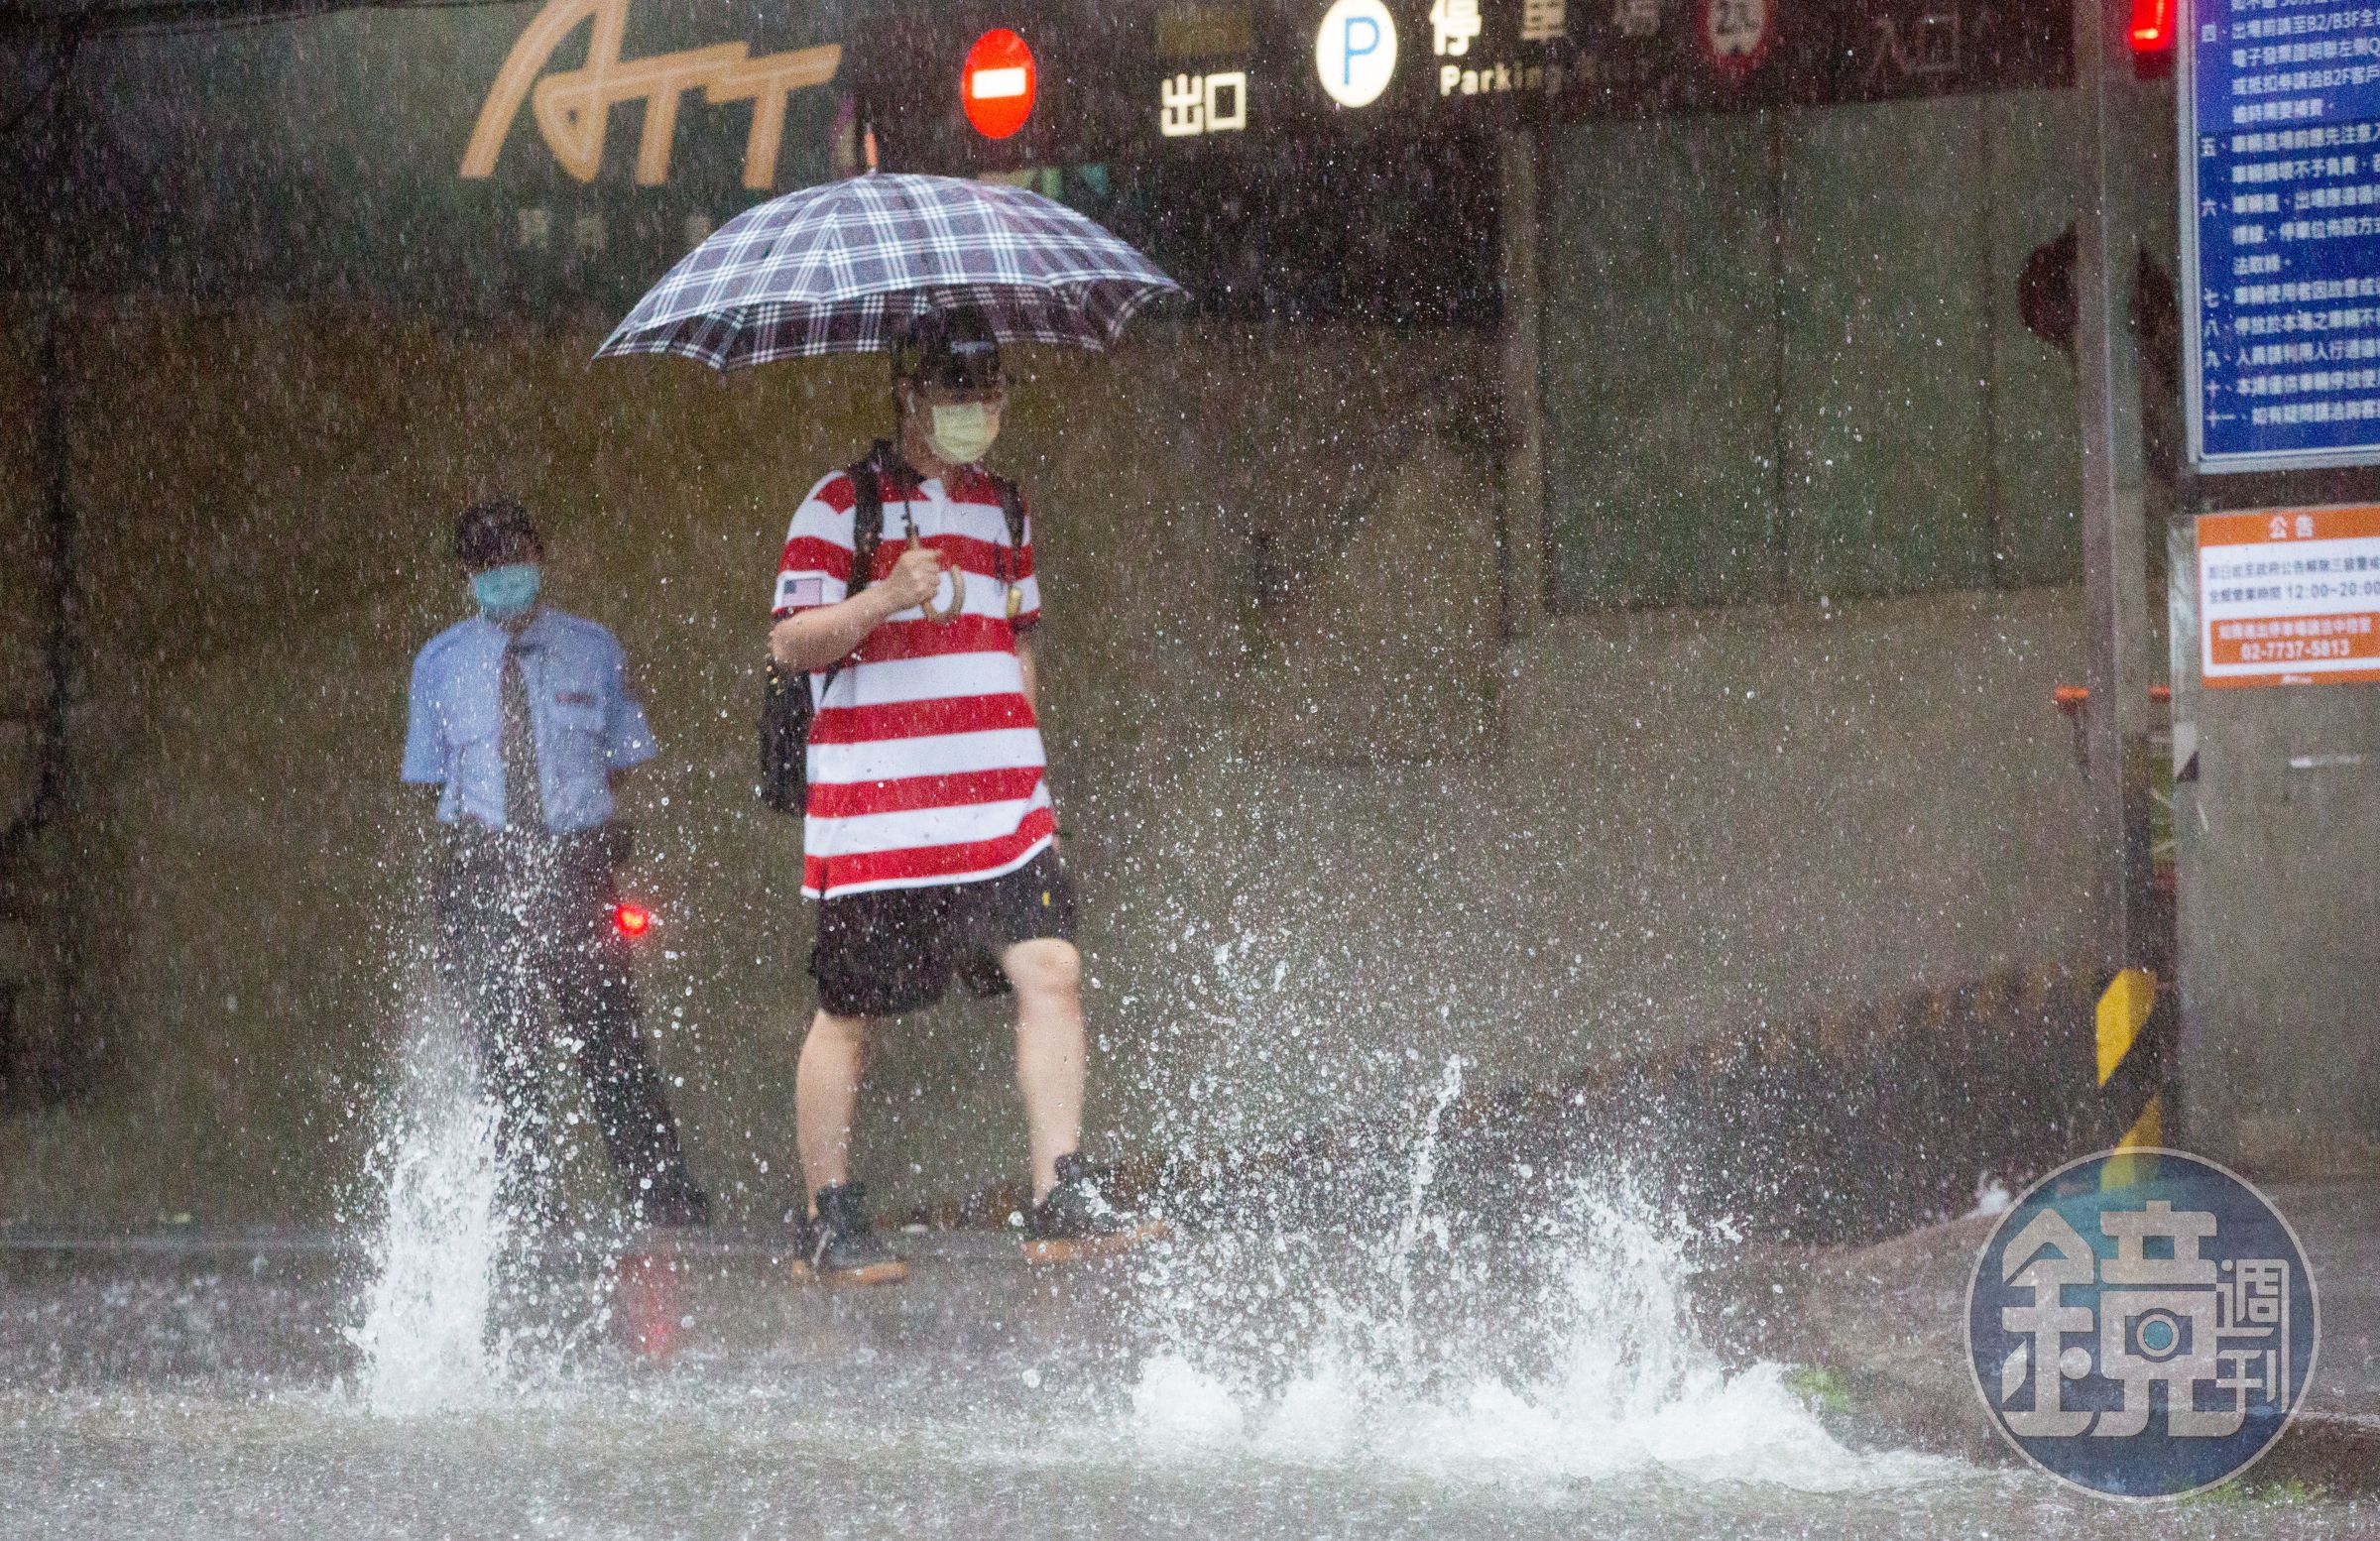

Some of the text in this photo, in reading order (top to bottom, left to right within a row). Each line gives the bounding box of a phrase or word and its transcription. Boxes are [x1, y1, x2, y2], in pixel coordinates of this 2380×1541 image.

[2232, 9, 2380, 39] 出場前請至B2/B3F全
[1343, 16, 1381, 85] P
[1440, 62, 1564, 97] Parking
[1161, 72, 1247, 138] 出口
[2234, 308, 2380, 335] 停放於本場之車輛不
[2235, 338, 2380, 365] 人員請利用人行通道
[2236, 369, 2380, 396] 本場僅供車輛停放使
[2252, 400, 2380, 424] 如有疑問請洽詢客
[2269, 515, 2315, 539] 公告
[2240, 639, 2349, 661] 02-7737-5813
